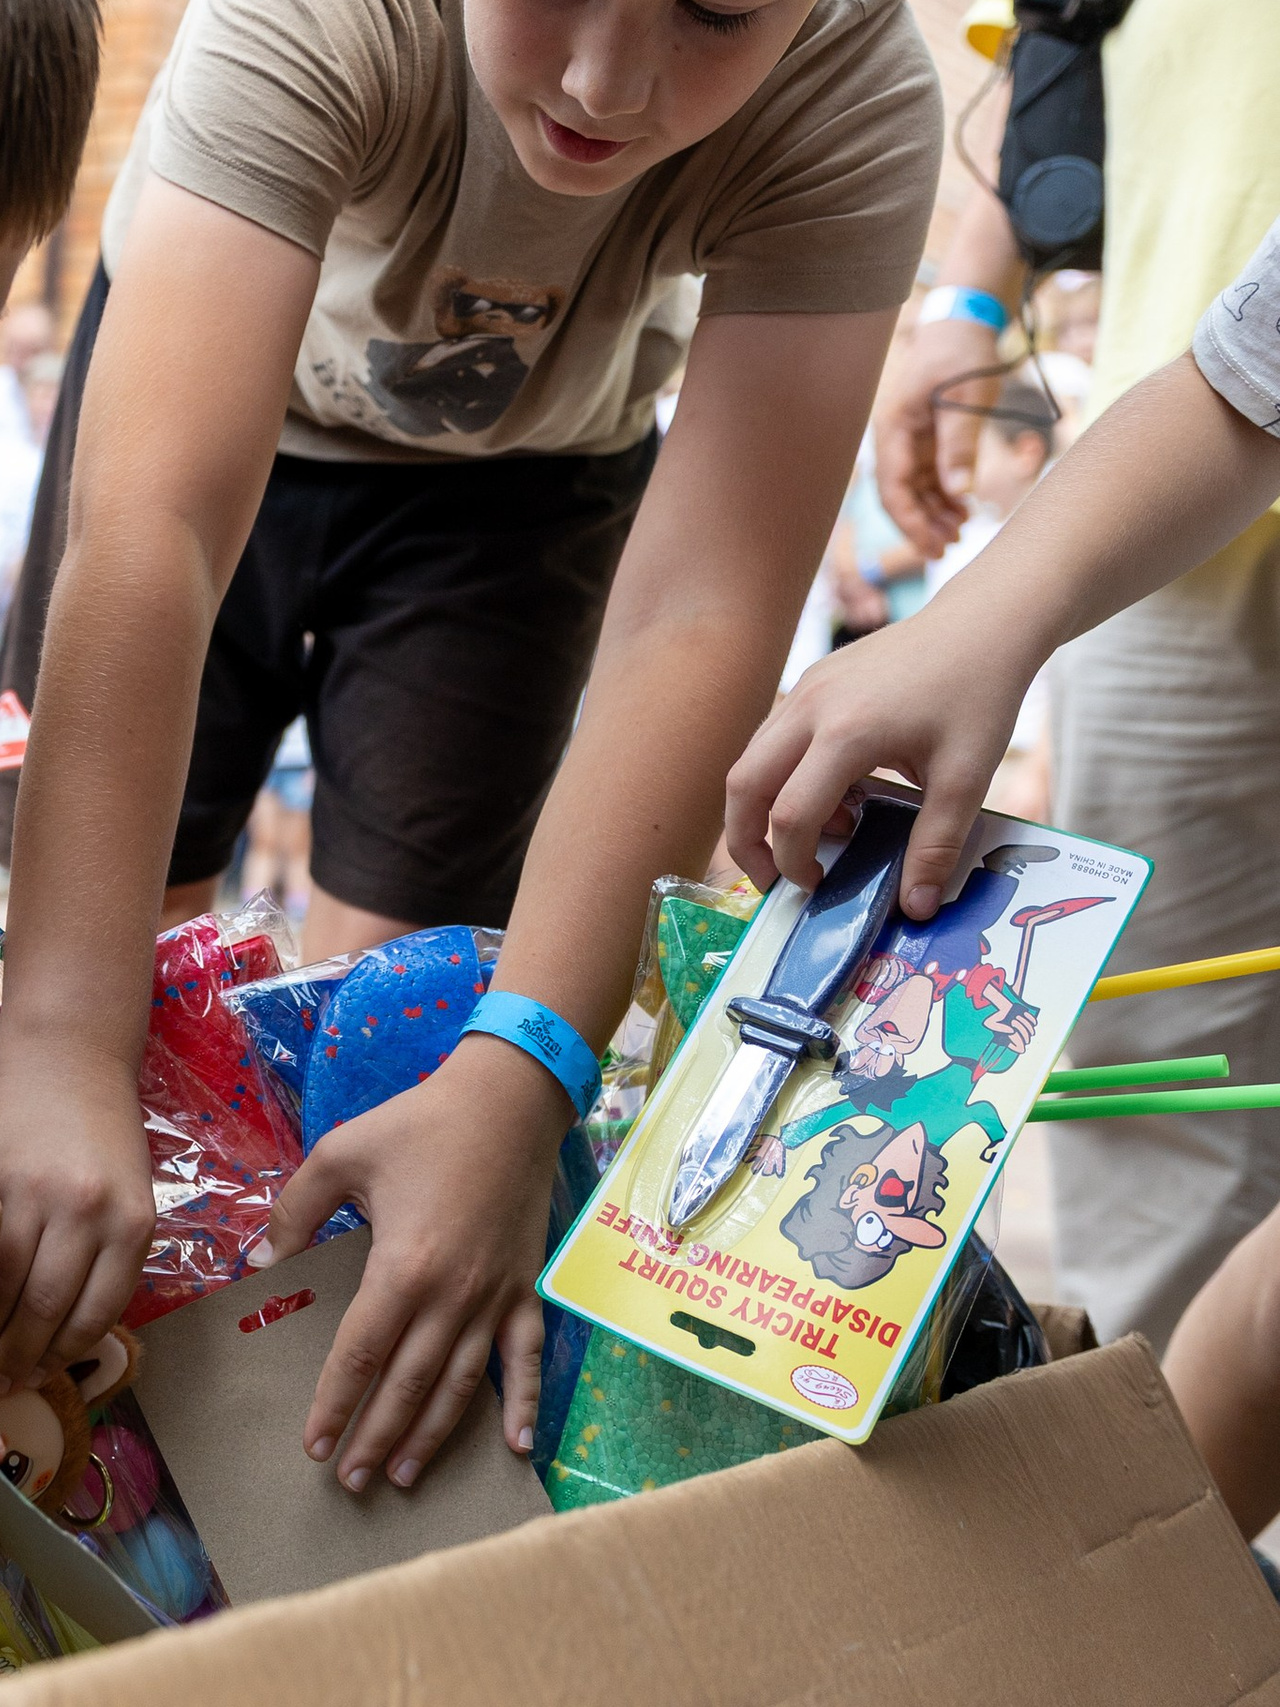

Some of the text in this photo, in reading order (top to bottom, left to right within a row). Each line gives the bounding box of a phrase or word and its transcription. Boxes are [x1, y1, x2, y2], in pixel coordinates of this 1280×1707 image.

[1069, 854, 1095, 865] CHINA
[1108, 865, 1133, 877] MADE
[595, 1202, 903, 1348] DISAPPEARING KNIFE
[618, 1248, 839, 1360] TRICKY SQUIRT
